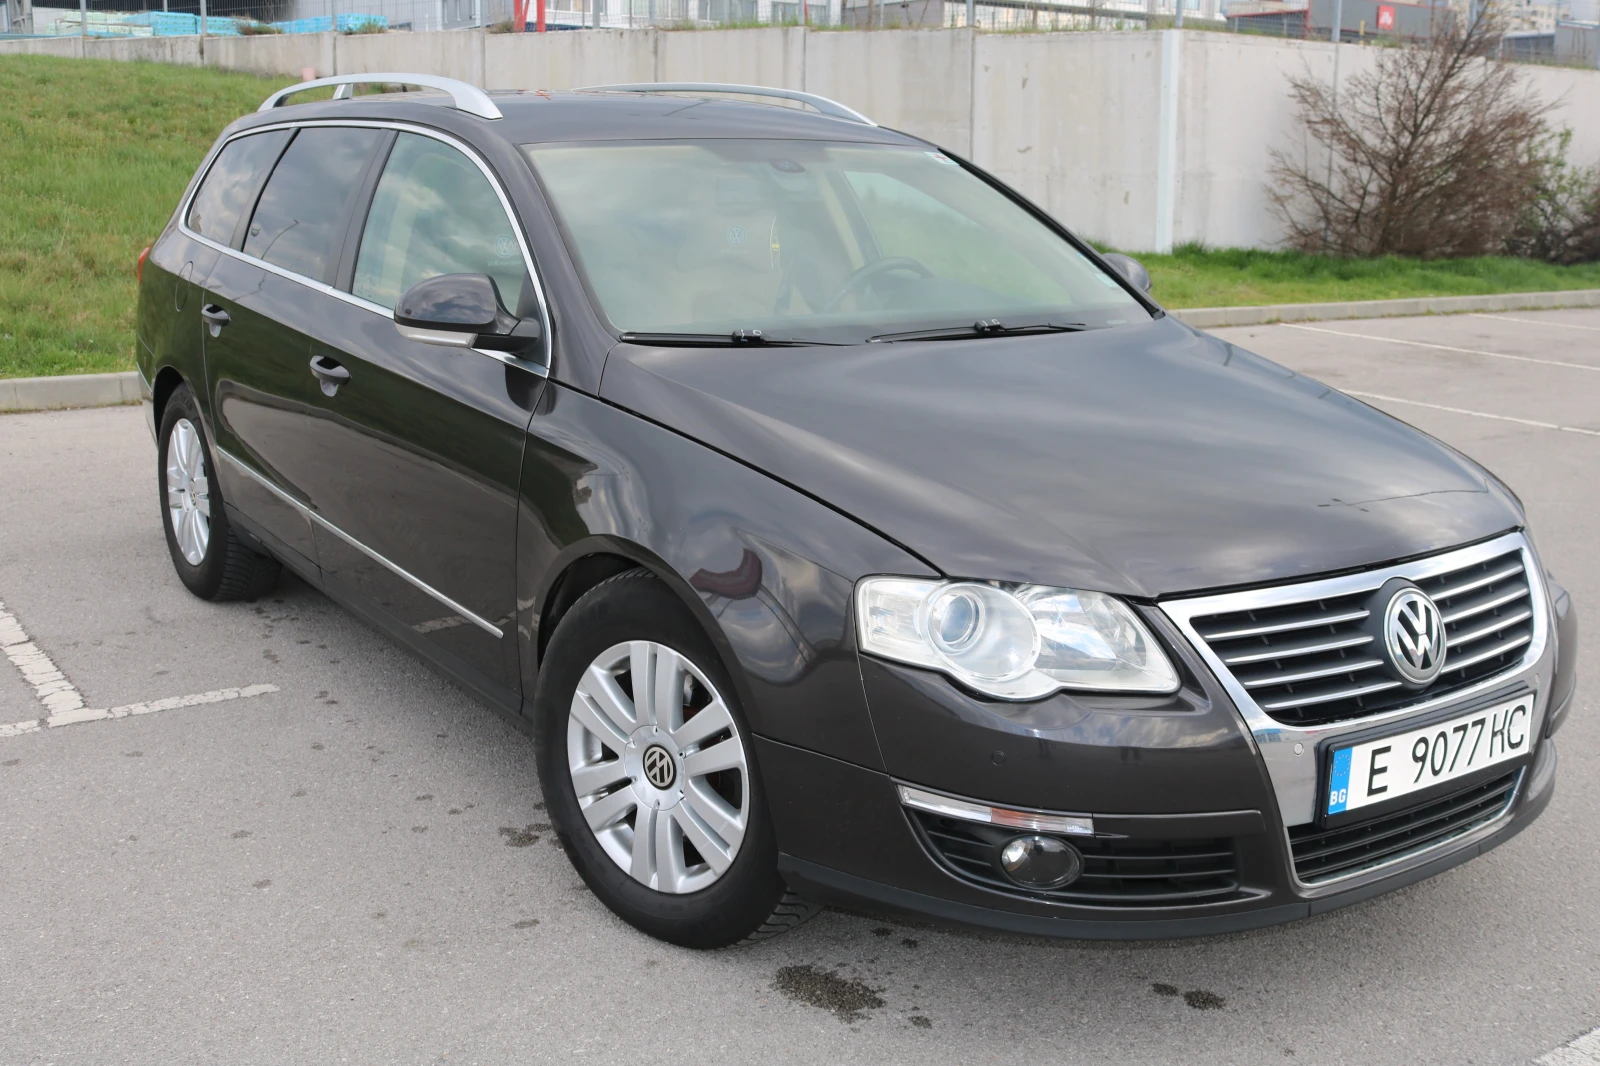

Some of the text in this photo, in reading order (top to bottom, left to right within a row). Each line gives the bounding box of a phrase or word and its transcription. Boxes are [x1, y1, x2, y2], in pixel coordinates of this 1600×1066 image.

[1385, 587, 1446, 683] VW
[1330, 788, 1347, 805] BG
[1366, 704, 1526, 797] E 9077 HC
